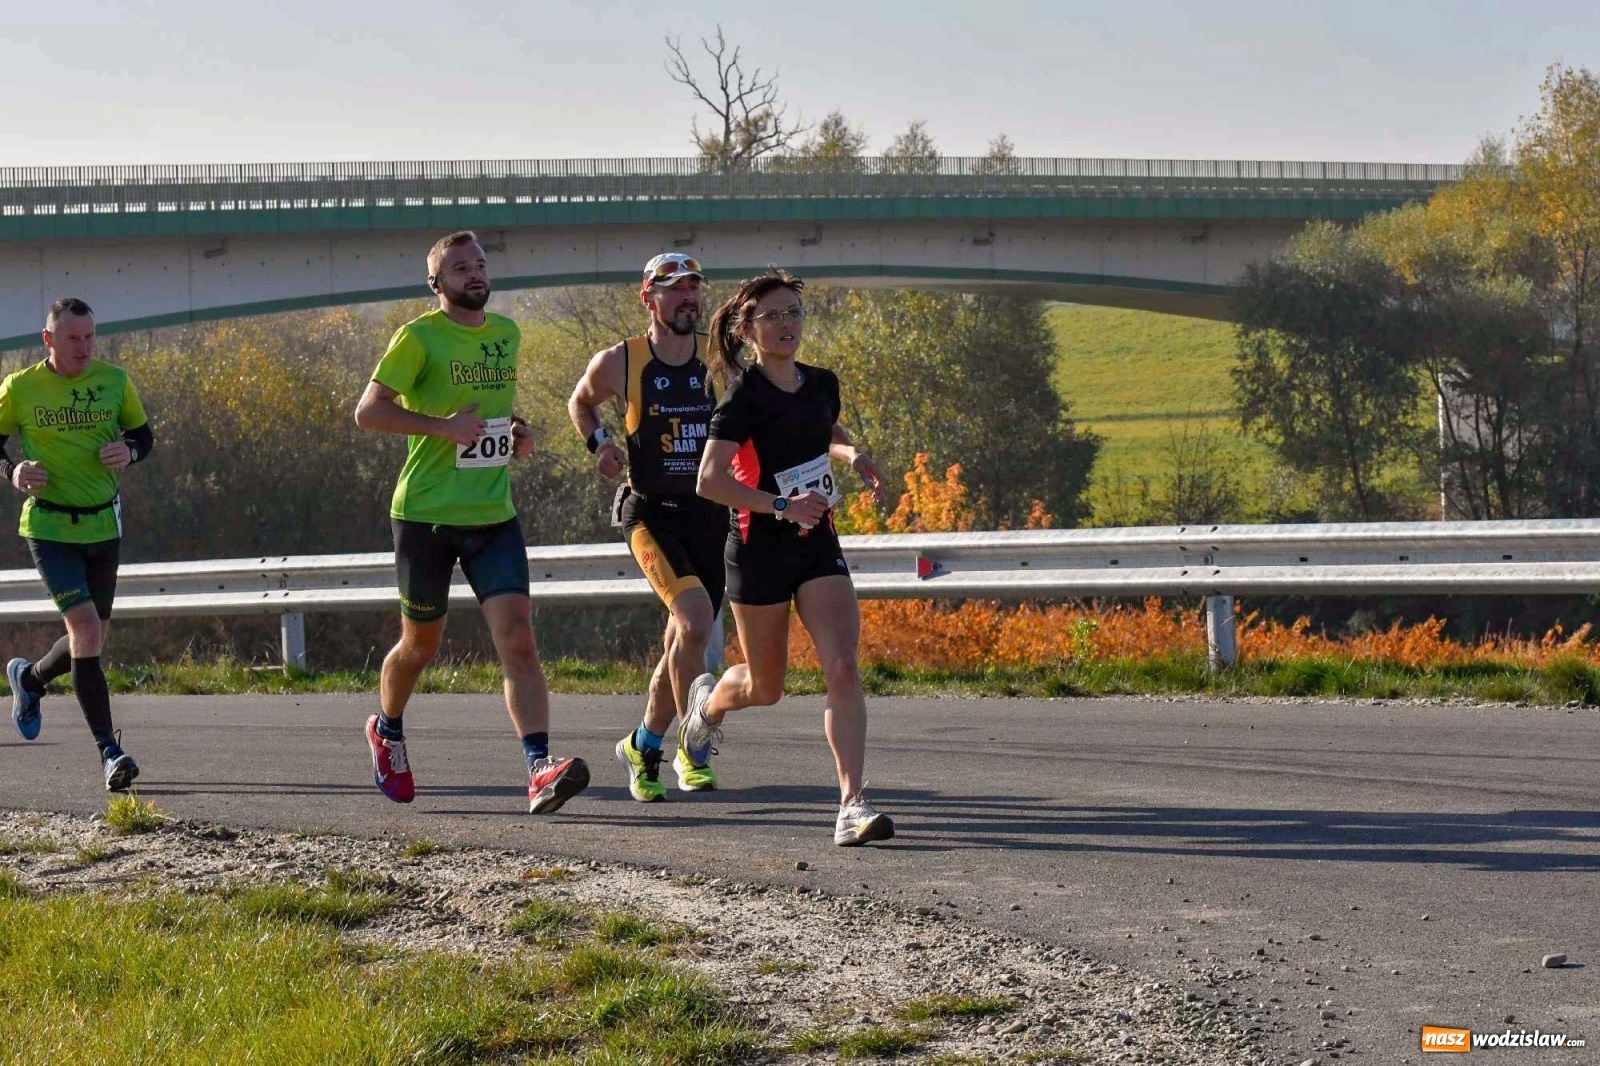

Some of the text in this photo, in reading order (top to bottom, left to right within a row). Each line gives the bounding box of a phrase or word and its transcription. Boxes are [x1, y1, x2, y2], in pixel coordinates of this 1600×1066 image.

[35, 405, 113, 428] Radlinioki
[669, 417, 707, 438] TEAM
[460, 435, 509, 459] 208
[661, 433, 697, 453] SAAR
